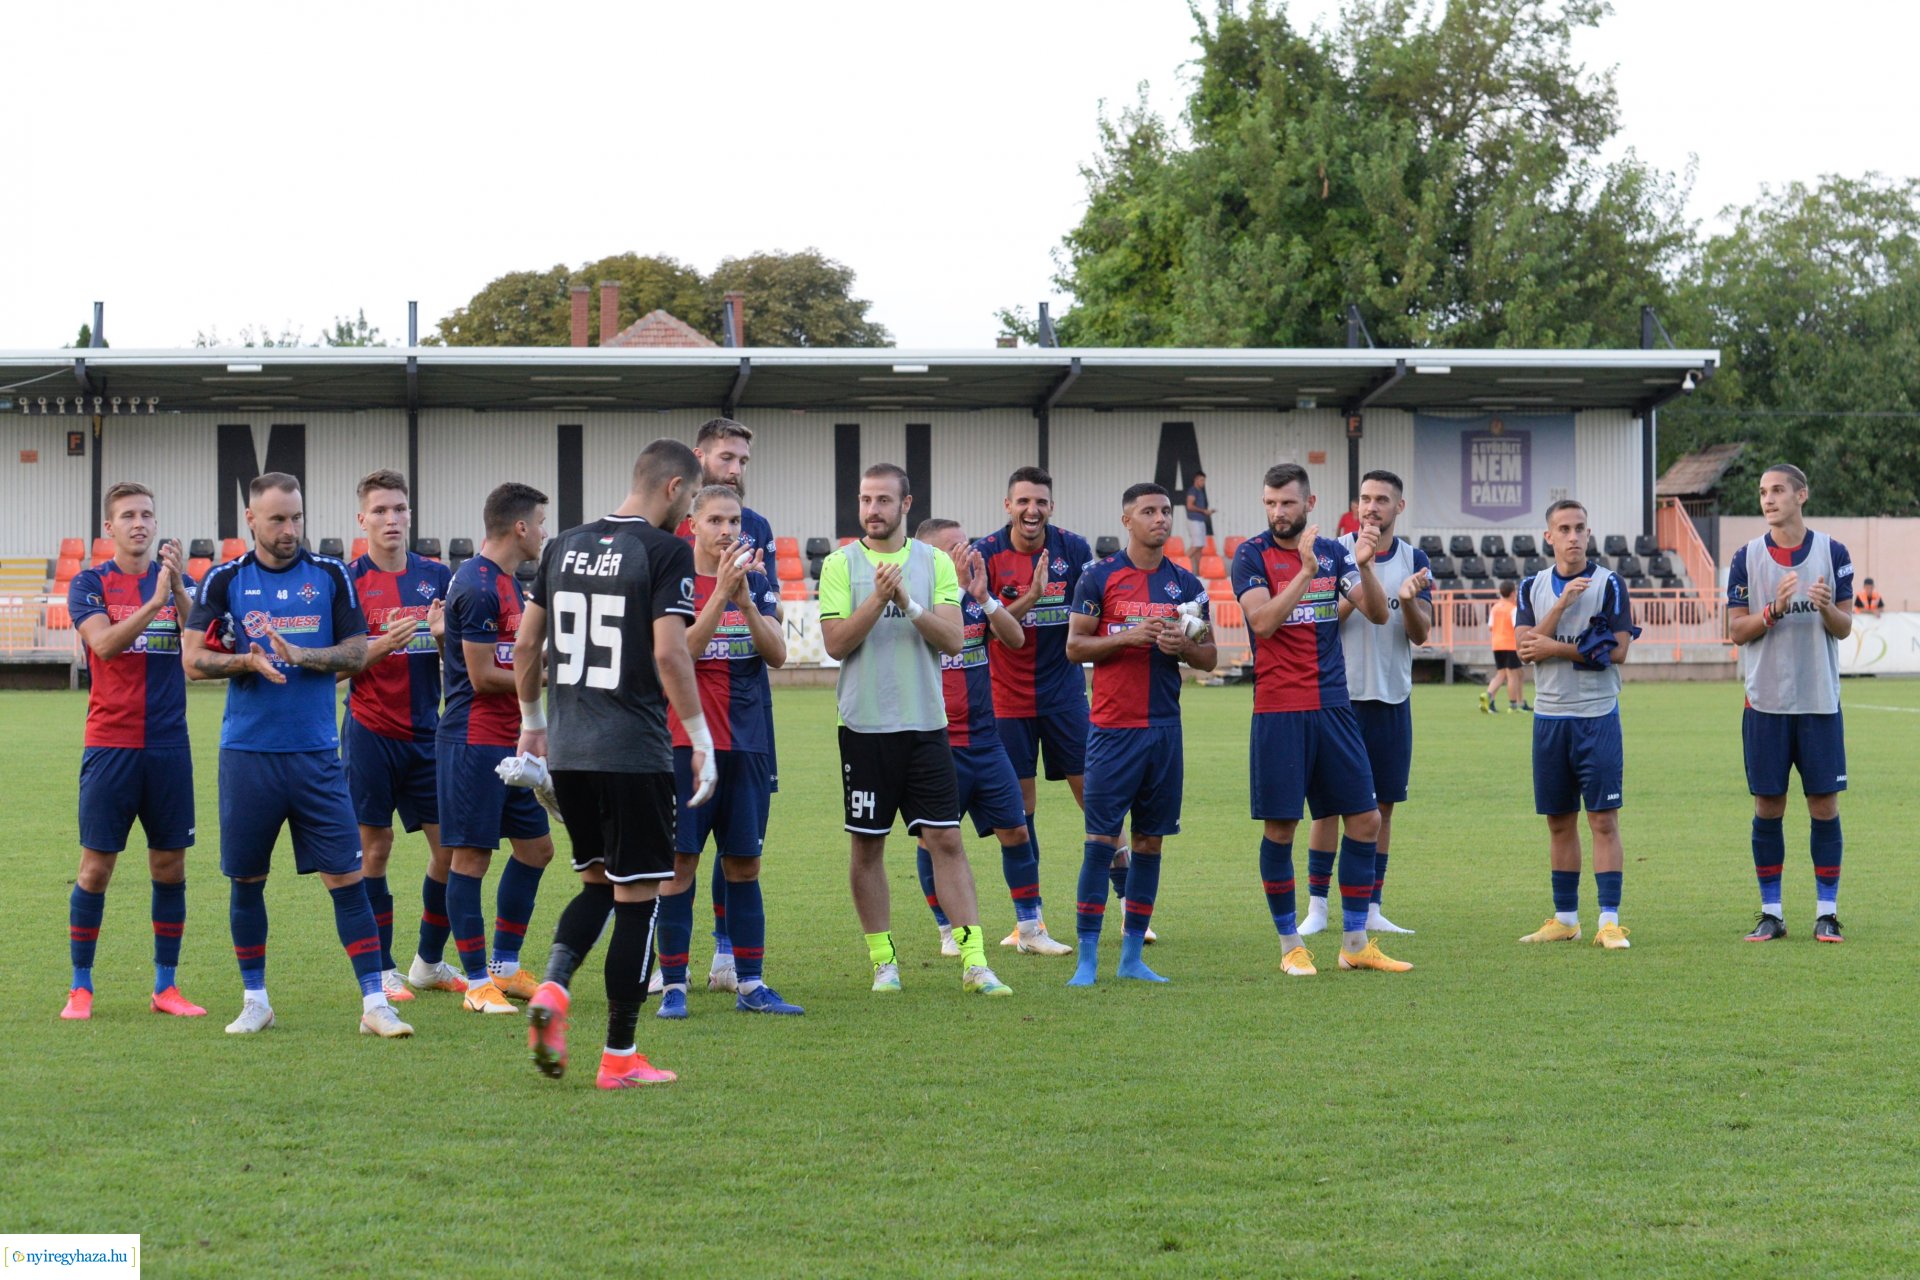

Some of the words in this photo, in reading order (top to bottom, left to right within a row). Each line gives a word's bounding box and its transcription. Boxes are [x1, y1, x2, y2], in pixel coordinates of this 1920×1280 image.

[1472, 455, 1521, 482] NEM
[1472, 482, 1521, 504] PÁLYA!
[561, 548, 623, 576] FEJÉR
[277, 590, 288, 600] 48
[271, 615, 321, 628] REVESZ
[553, 591, 626, 690] 95
[851, 790, 875, 820] 94
